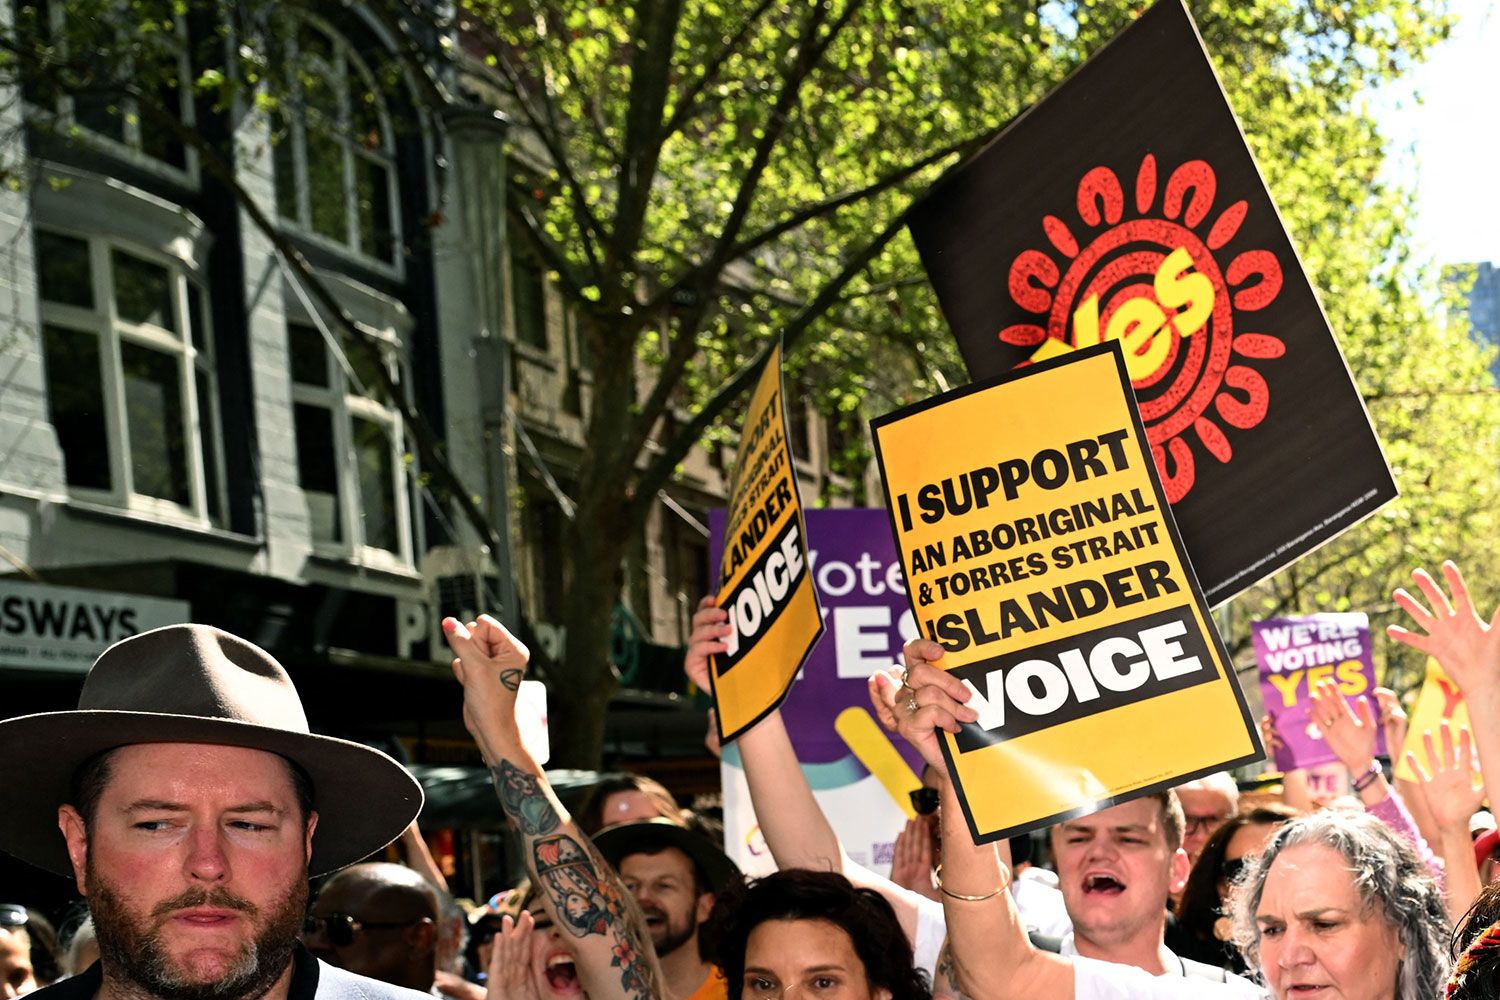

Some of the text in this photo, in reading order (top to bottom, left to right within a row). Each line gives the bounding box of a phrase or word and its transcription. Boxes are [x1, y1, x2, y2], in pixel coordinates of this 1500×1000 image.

[897, 429, 1130, 532] I SUPPORT
[911, 541, 947, 576] AN
[952, 488, 1155, 564] ABORIGINAL
[918, 583, 935, 607] &
[935, 552, 1048, 600] TORRES
[1050, 521, 1160, 569] STRAIT
[0, 596, 138, 642] SWAYS
[925, 559, 1181, 653] ISLANDER
[1260, 622, 1360, 651] WE'RE
[963, 620, 1203, 732] VOICE
[1264, 638, 1362, 673] VOTING
[1267, 659, 1368, 707] YES
